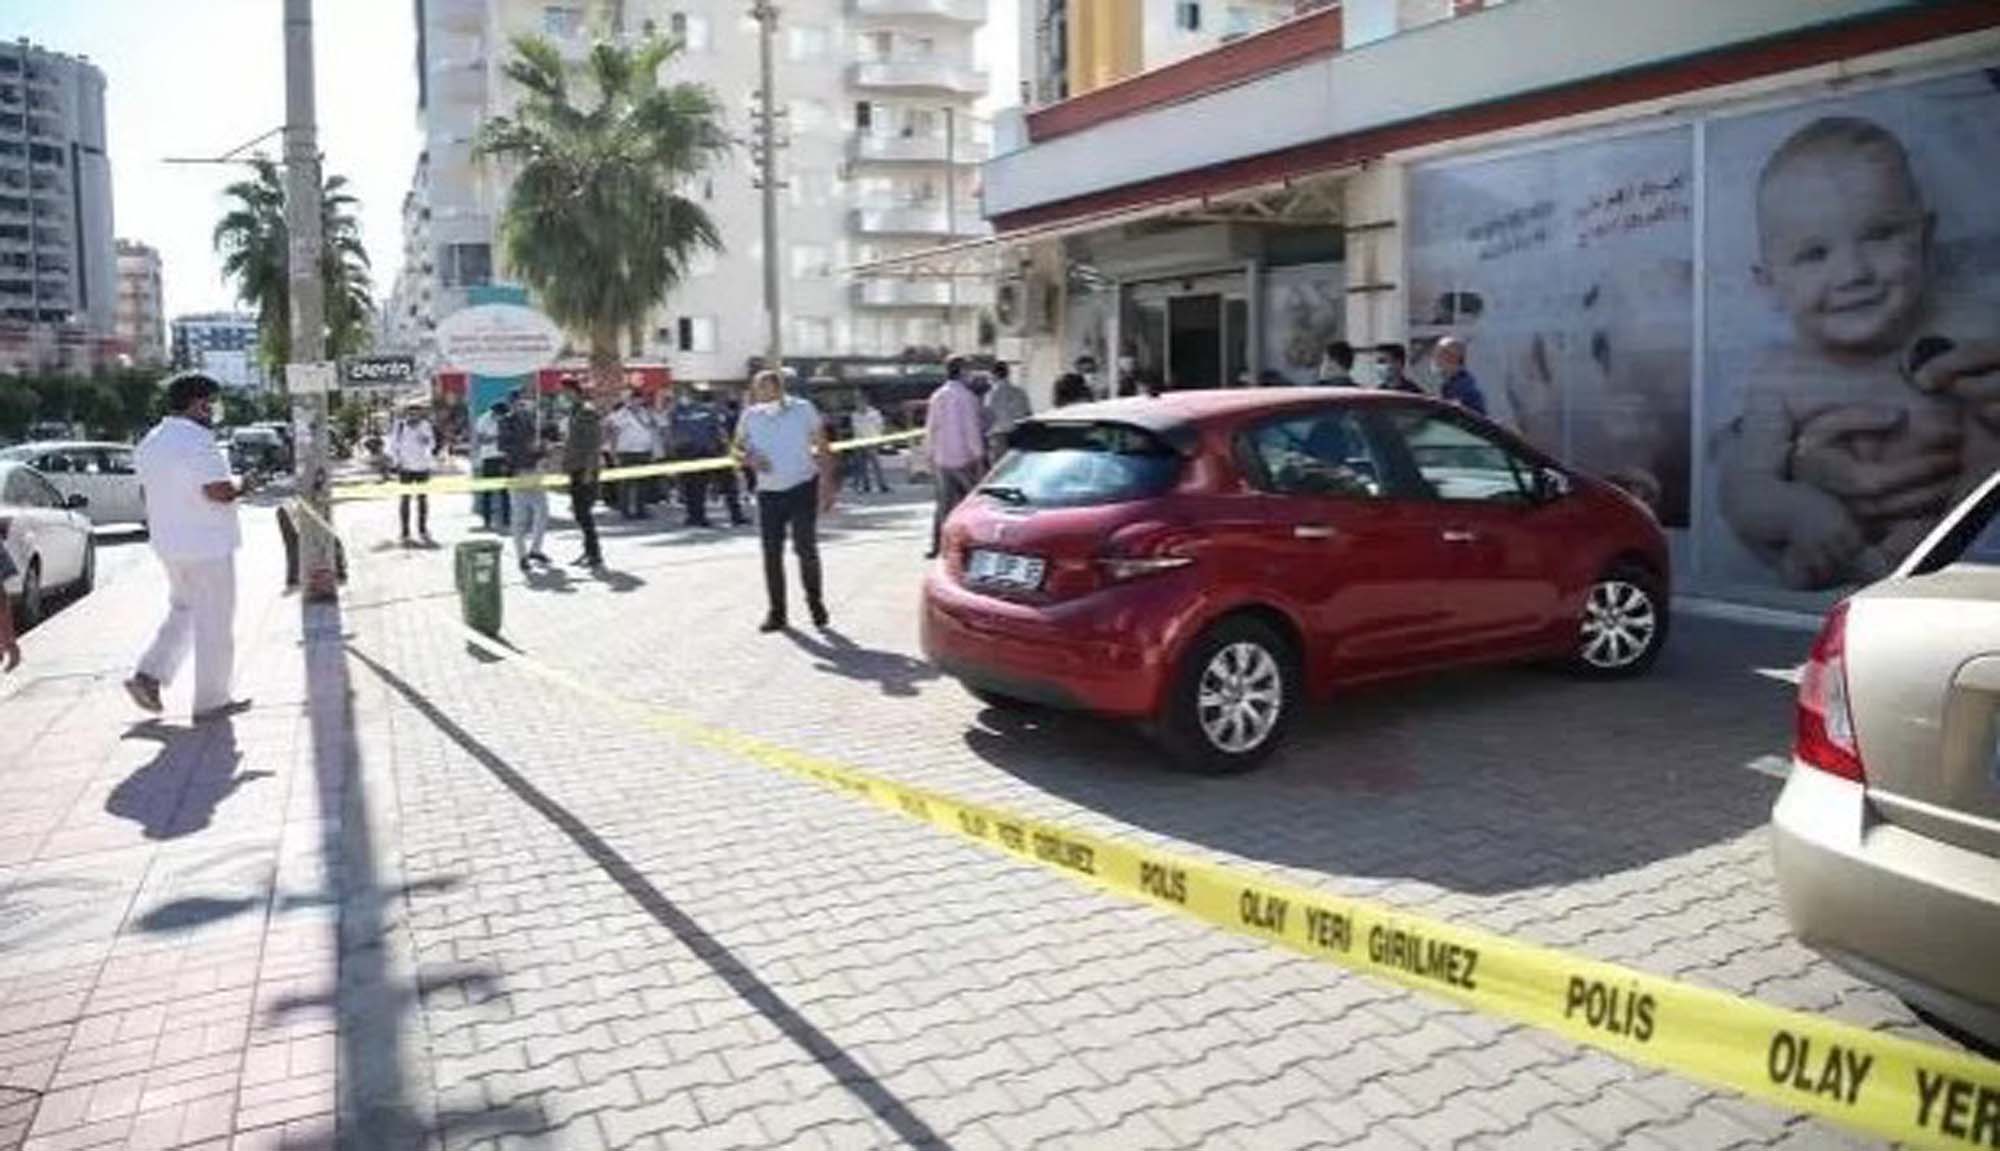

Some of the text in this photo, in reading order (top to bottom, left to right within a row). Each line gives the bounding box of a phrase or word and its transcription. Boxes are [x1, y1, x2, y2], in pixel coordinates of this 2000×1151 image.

[1139, 860, 1187, 903] POLİS
[1239, 888, 1289, 933] OLAY
[1564, 973, 1659, 1042] POLİS
[1767, 1030, 1875, 1105] OLAY
